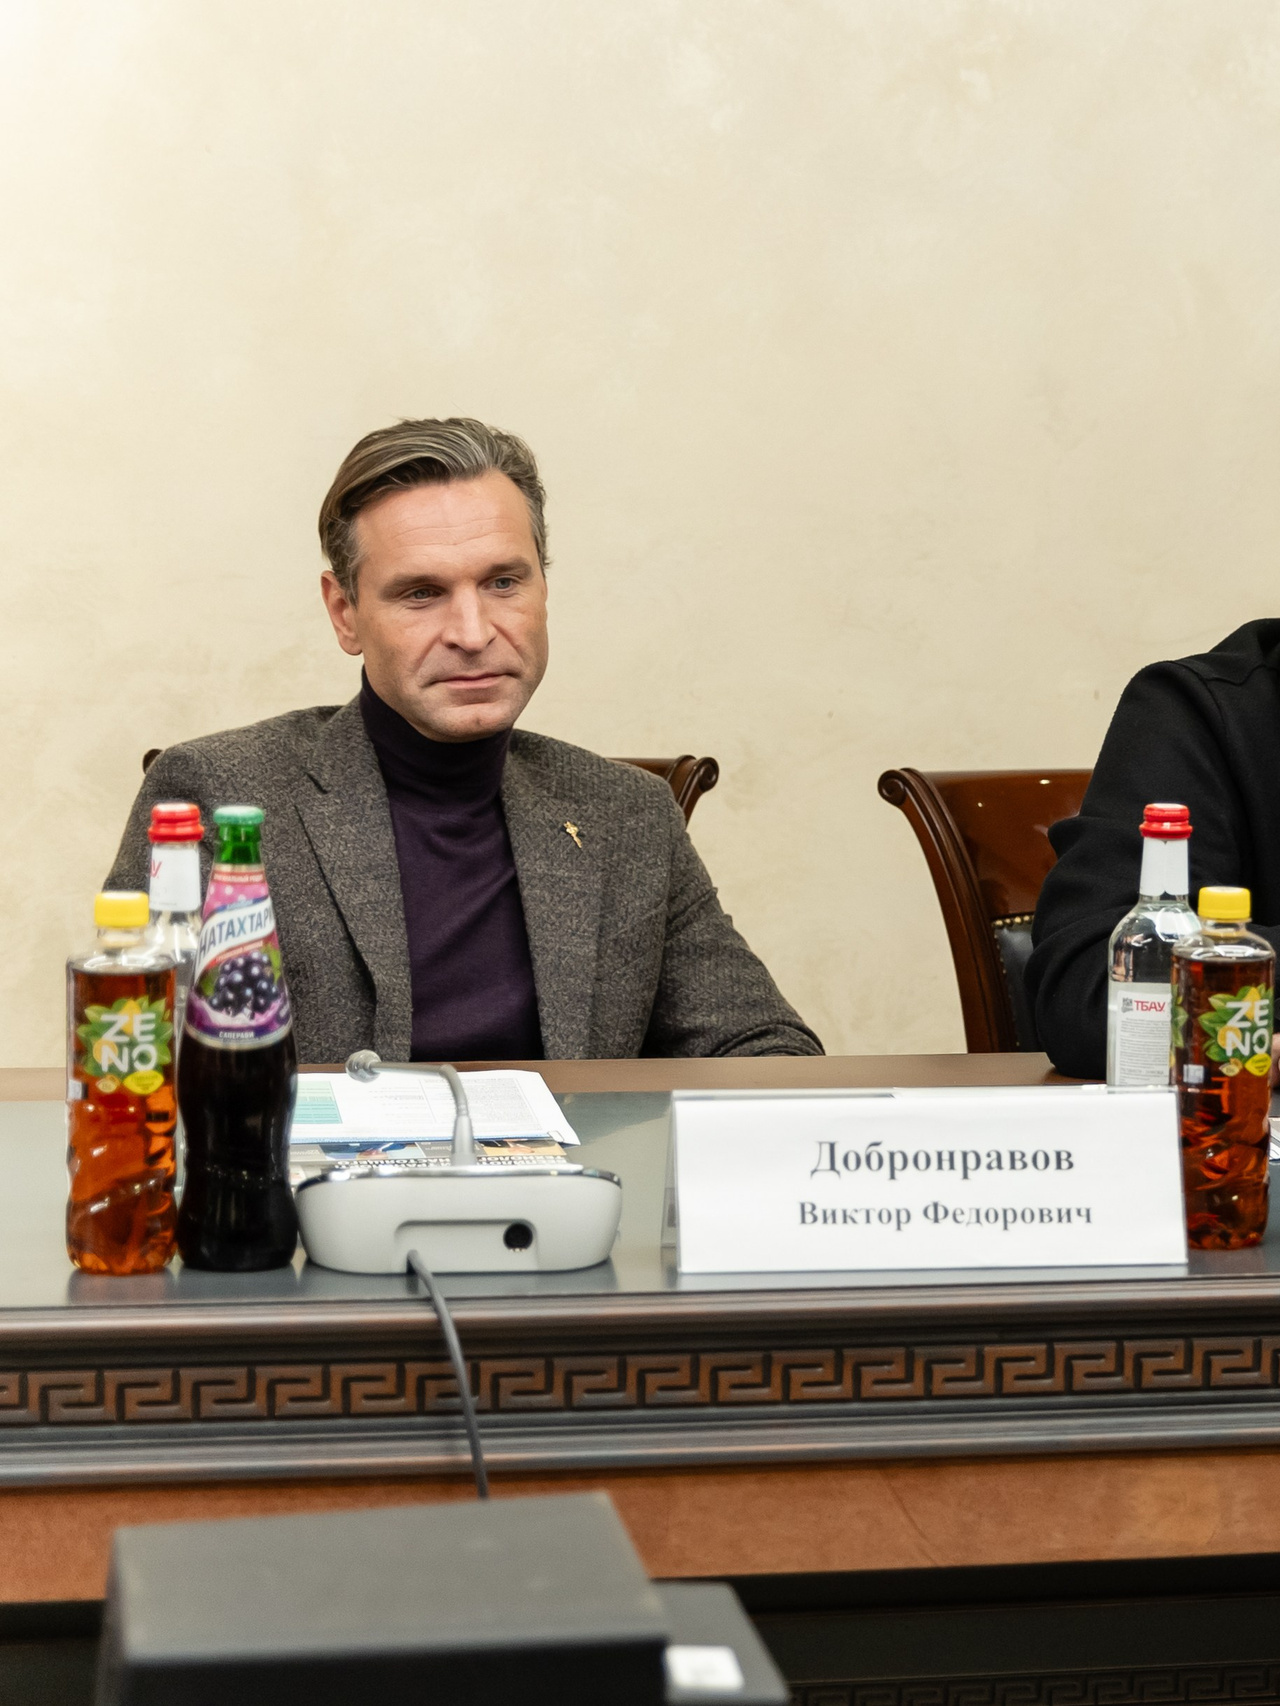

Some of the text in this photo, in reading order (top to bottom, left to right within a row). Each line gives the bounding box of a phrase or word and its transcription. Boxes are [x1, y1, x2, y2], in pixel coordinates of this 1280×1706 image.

[1134, 999, 1166, 1012] ТБАУ
[218, 1031, 255, 1039] САПЕРАВИ
[810, 1141, 1074, 1181] Добронравов
[800, 1201, 1092, 1232] Виктор Федорович
